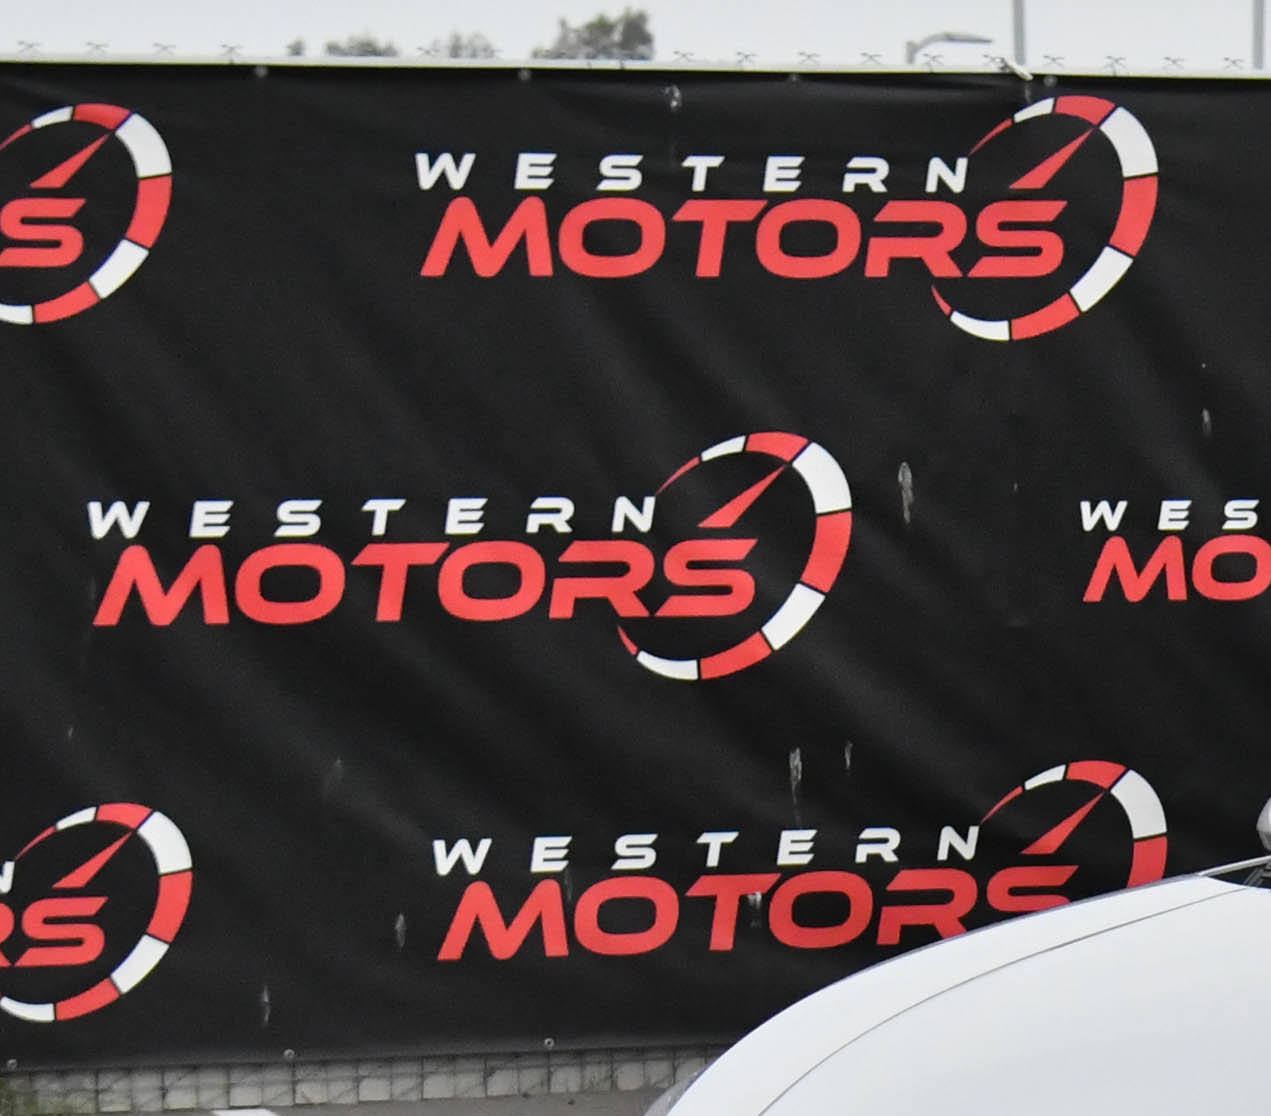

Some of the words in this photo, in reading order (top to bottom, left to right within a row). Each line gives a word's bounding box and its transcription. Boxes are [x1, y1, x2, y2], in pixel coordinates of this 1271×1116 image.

[416, 152, 968, 193] WESTERN
[420, 195, 1068, 279] MOTORS
[87, 496, 656, 540] WESTERN
[92, 538, 758, 627] MOTORS
[432, 826, 979, 876] WESTERN
[437, 865, 1078, 961] MOTORS
